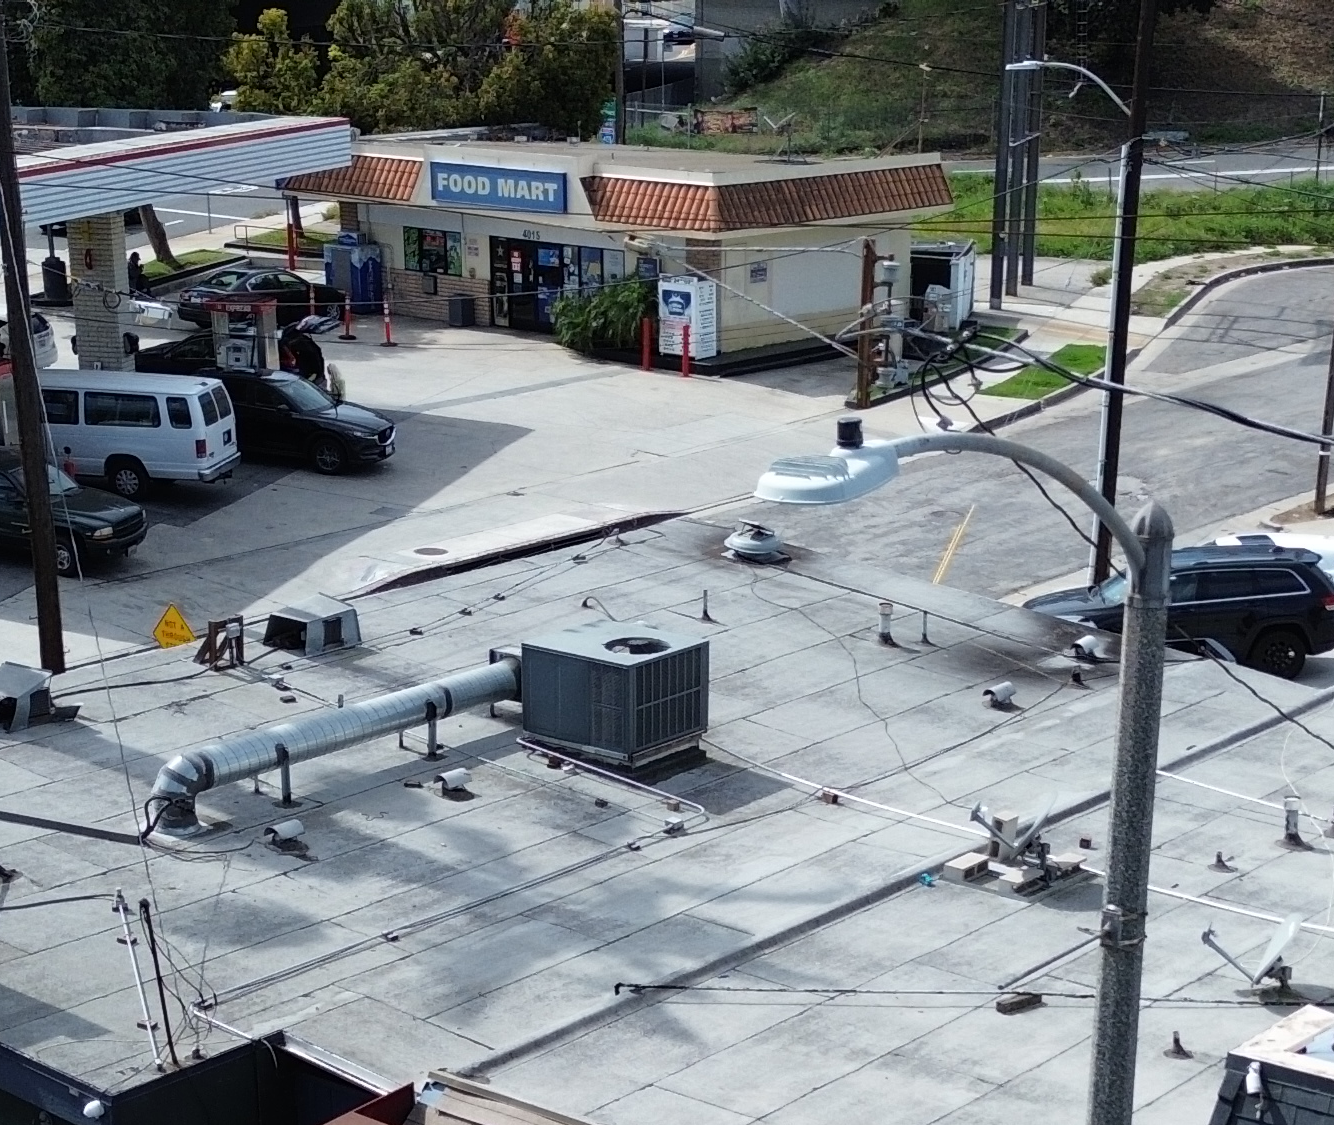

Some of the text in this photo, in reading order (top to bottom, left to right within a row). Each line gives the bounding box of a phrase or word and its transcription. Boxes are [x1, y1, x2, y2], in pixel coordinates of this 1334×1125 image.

[437, 173, 558, 202] FOOD MART
[522, 229, 540, 241] 4015
